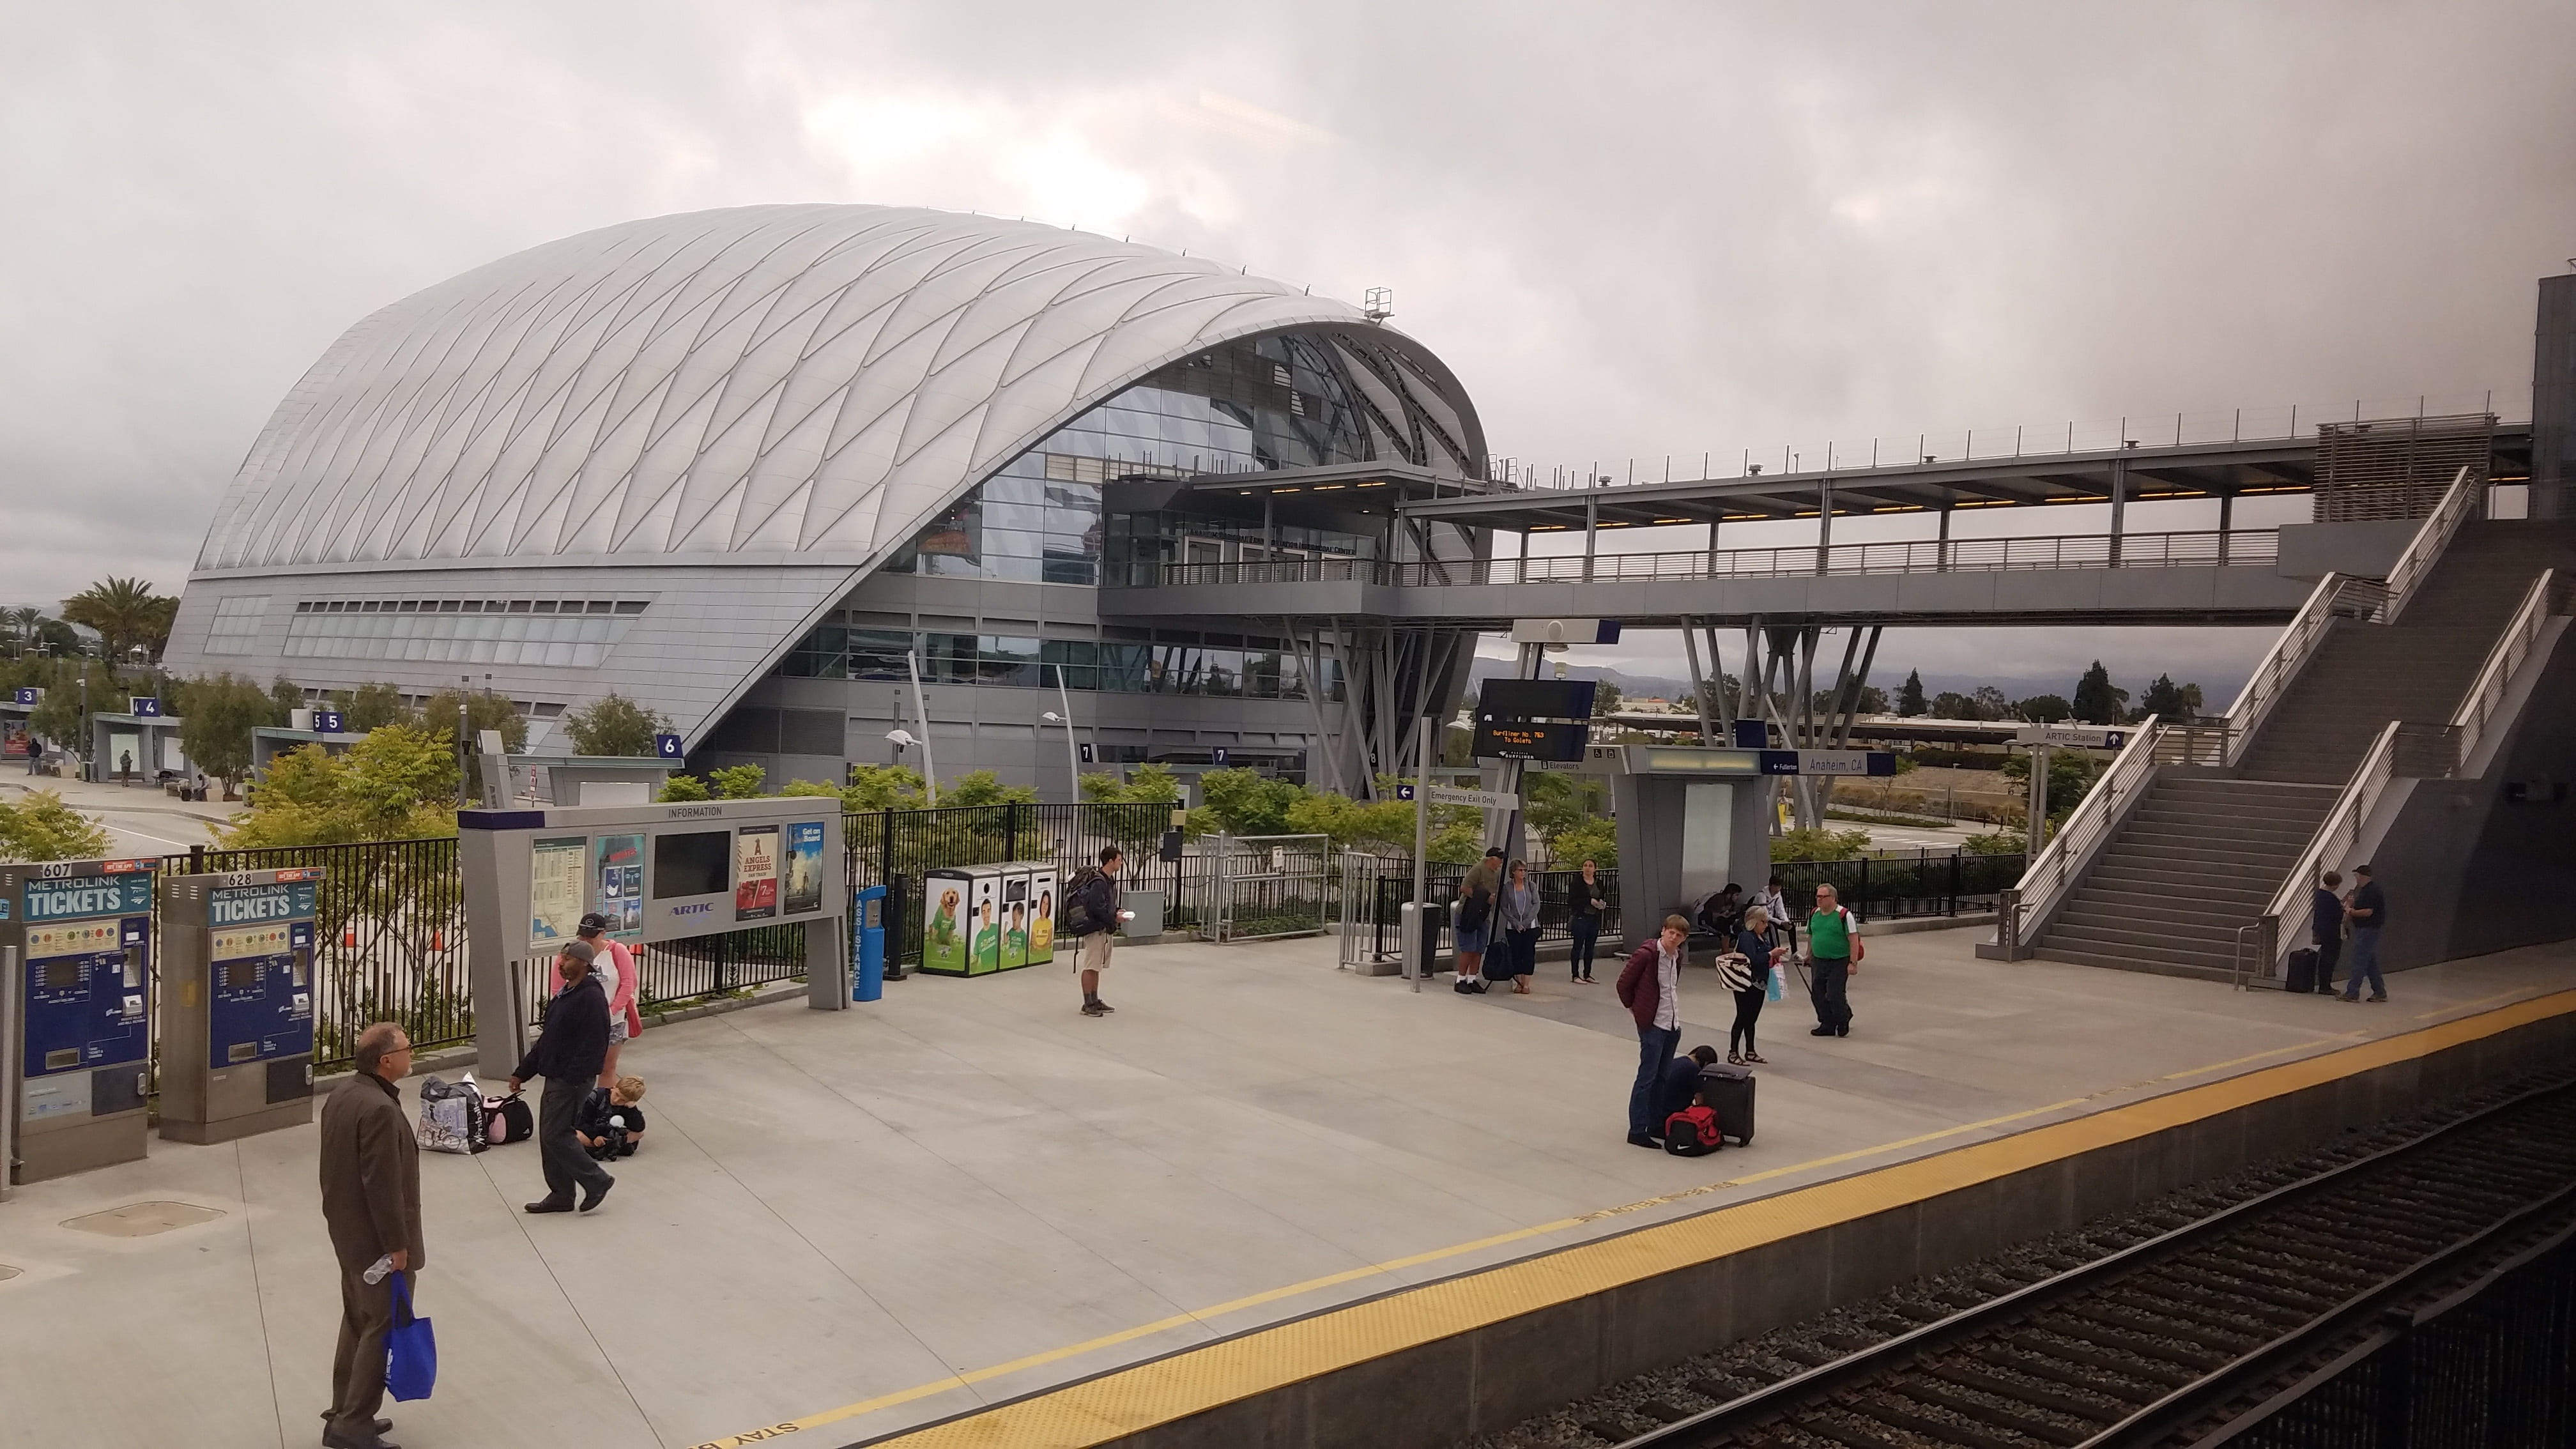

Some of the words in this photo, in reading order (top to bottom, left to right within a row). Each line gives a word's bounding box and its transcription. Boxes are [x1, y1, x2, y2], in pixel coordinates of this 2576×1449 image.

[24, 691, 32, 701] 3
[146, 702, 155, 713] 4
[315, 715, 320, 728] 5
[329, 715, 338, 728] 5
[2045, 732, 2070, 740] ARTIC
[2073, 733, 2101, 742] Station
[665, 739, 675, 753] 6
[1083, 746, 1089, 759] 7
[1218, 749, 1224, 762] 7
[1370, 753, 1376, 763] 8
[1550, 762, 1579, 770] Elevators
[1809, 758, 1848, 772] Anaheim,
[1851, 758, 1862, 771] CA
[1431, 792, 1466, 803] Emergency
[1468, 794, 1481, 803] Exit
[1482, 795, 1497, 806] Only
[668, 806, 722, 818] INFORMATION
[745, 855, 770, 864] ANGELS
[44, 864, 71, 877] 607
[744, 863, 772, 872] EXPRESS
[28, 876, 120, 891] METROLINK
[229, 873, 252, 886] 628
[213, 884, 289, 900] METROLINK
[28, 887, 121, 916] TICKETS
[213, 895, 290, 922] TICKETS
[669, 902, 714, 916] ARTIC
[854, 899, 862, 989] ASSISTANCE
[733, 1423, 800, 1445] STAY
